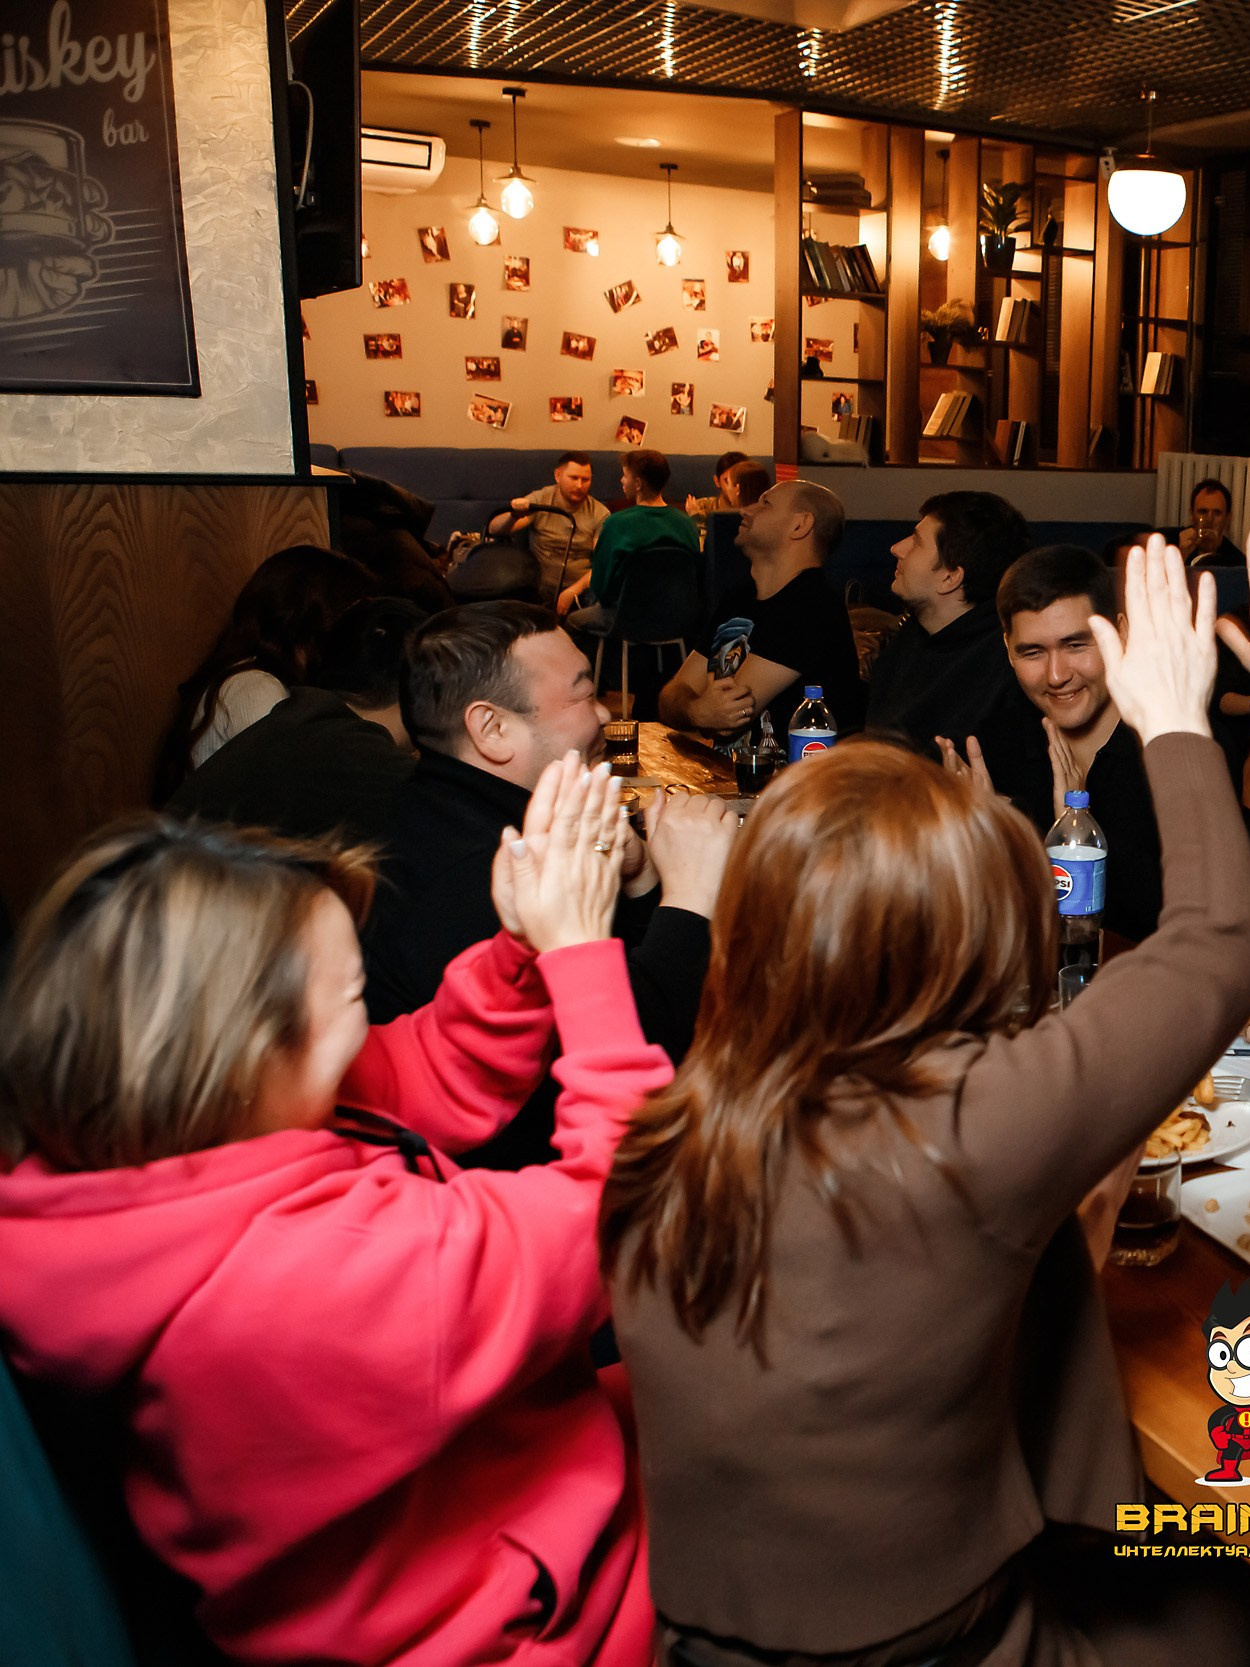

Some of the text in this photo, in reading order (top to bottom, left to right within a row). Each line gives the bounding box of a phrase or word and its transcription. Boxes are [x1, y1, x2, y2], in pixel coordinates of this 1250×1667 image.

[0, 0, 157, 103] iskey
[102, 107, 149, 147] bar
[1055, 878, 1071, 888] PSI
